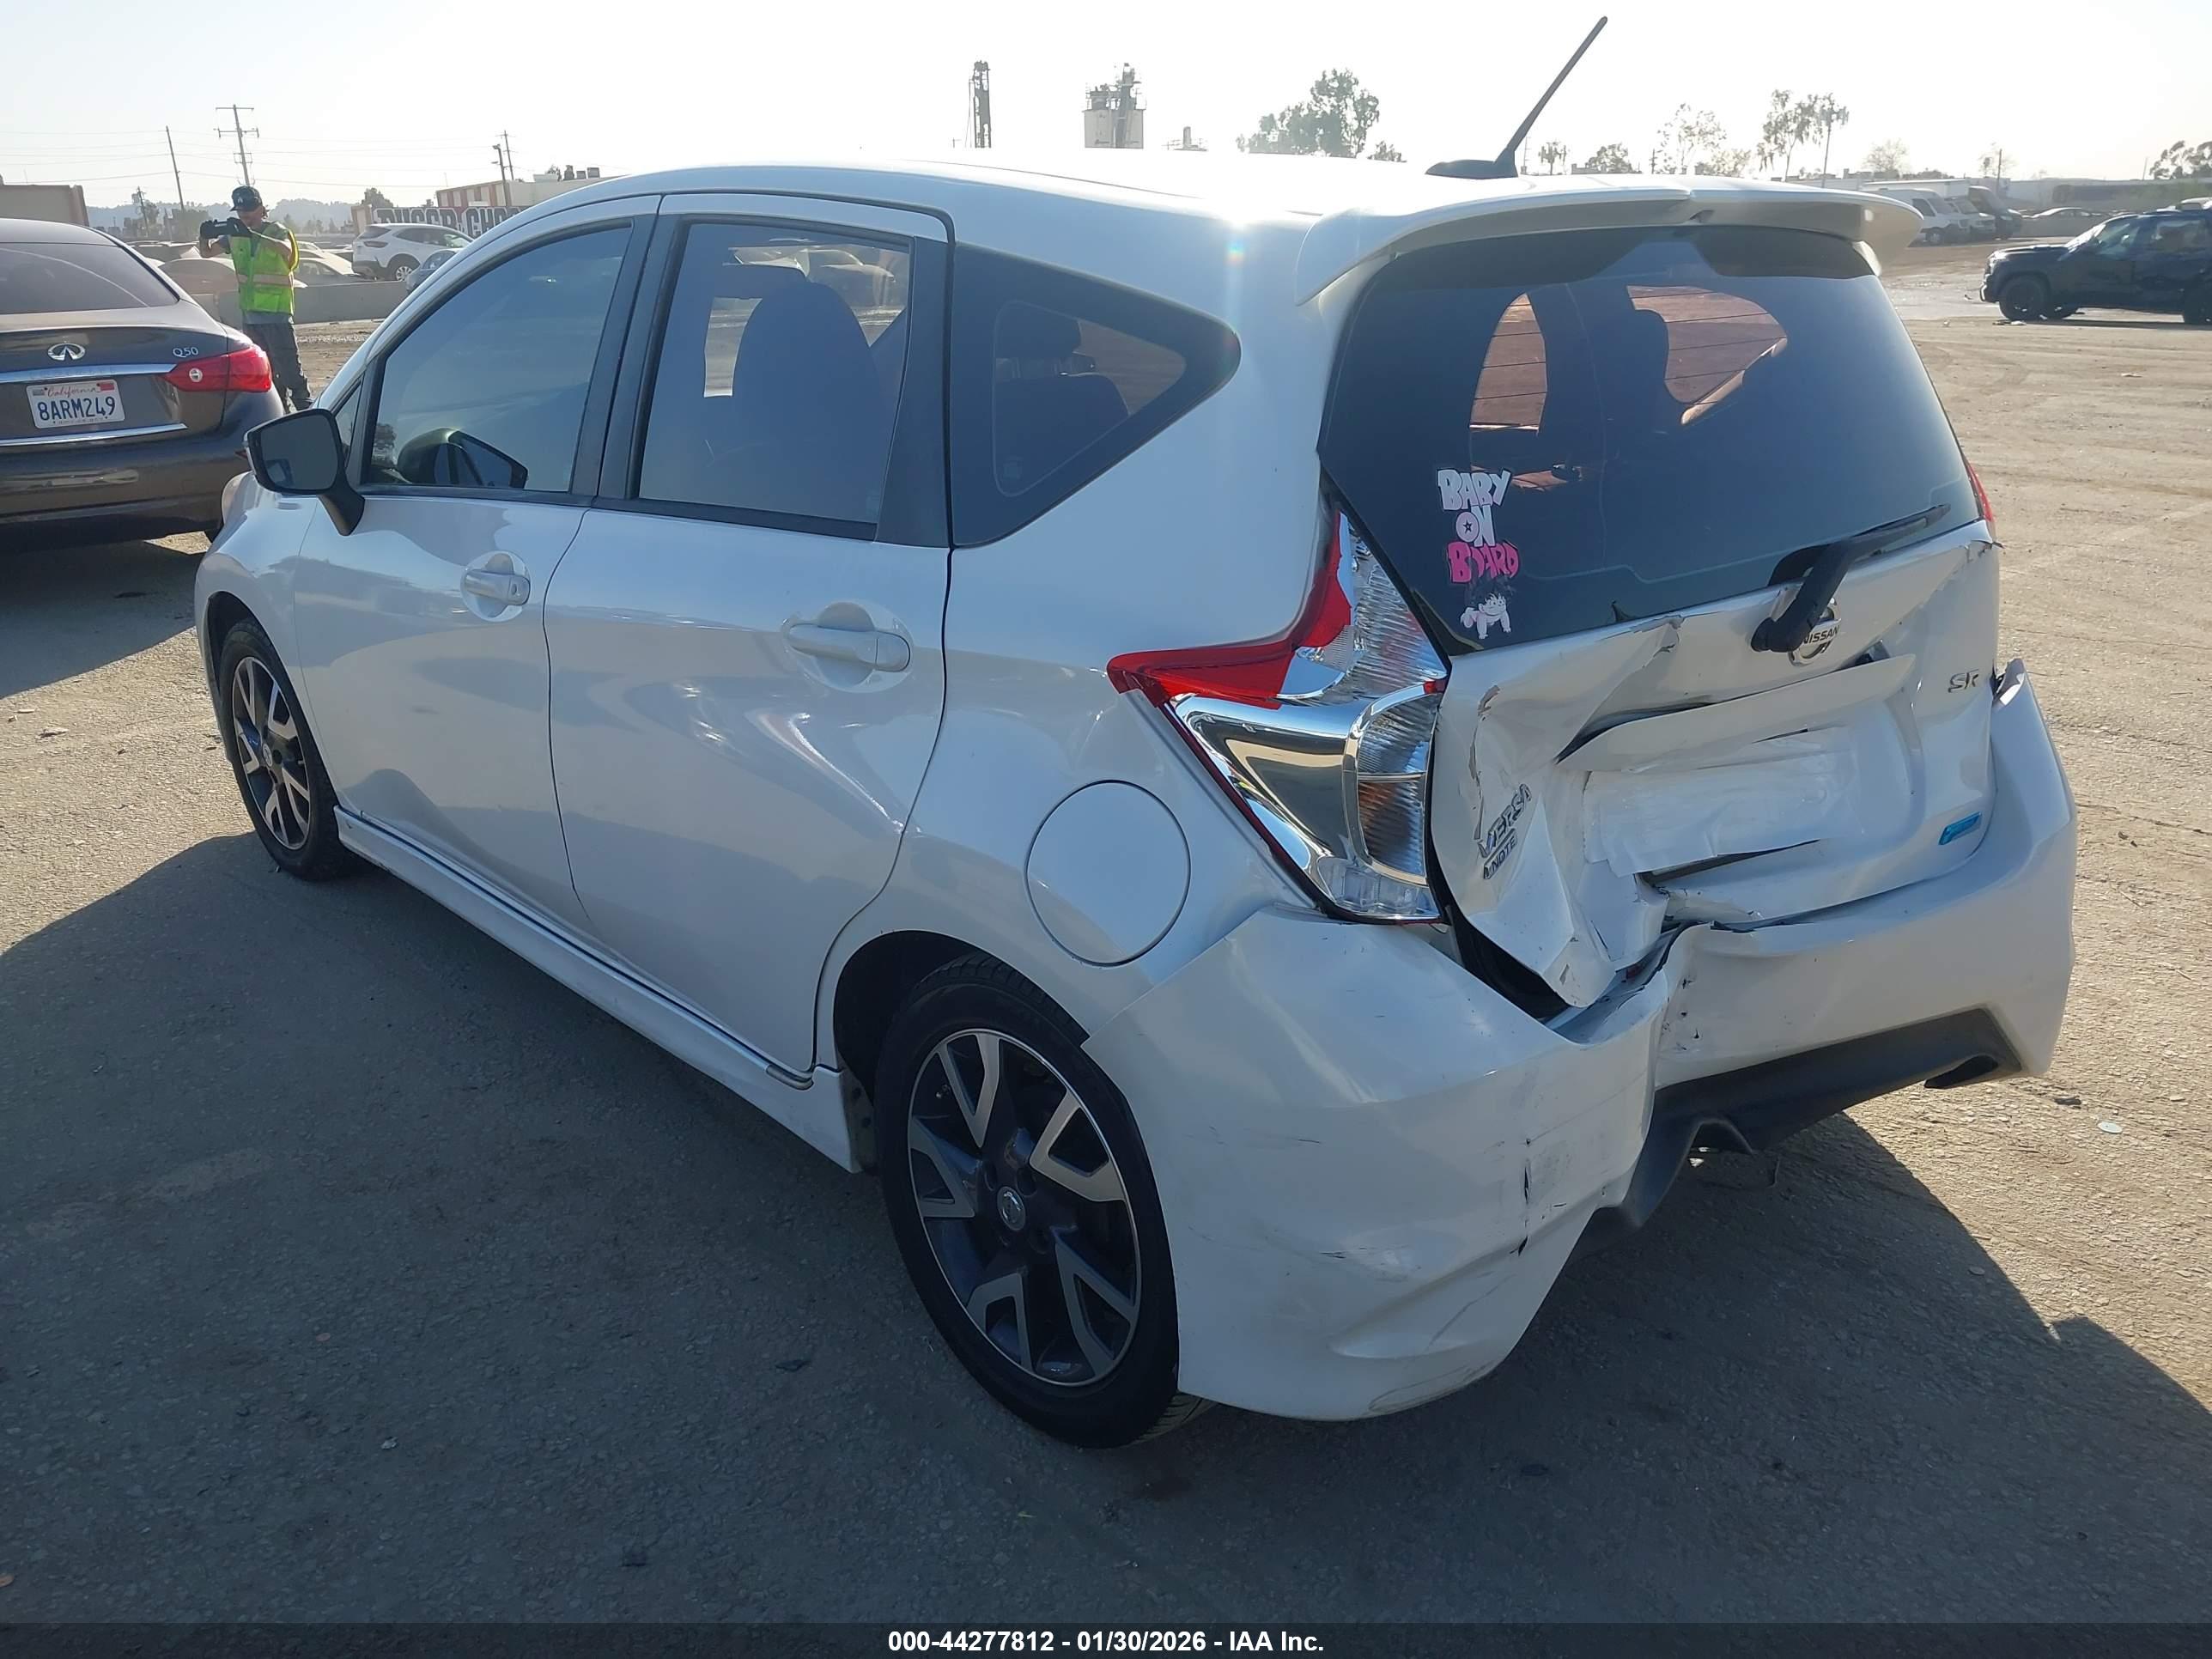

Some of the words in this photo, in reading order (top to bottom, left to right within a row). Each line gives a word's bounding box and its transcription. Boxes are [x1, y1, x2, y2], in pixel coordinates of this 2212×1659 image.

[173, 346, 198, 358] Q50
[37, 396, 116, 421] 8ARM249
[47, 384, 100, 398] California
[1437, 469, 1511, 510] BABY
[1455, 503, 1496, 547] ON
[1477, 783, 1532, 859] VERSA
[1491, 836, 1516, 872] NOTE
